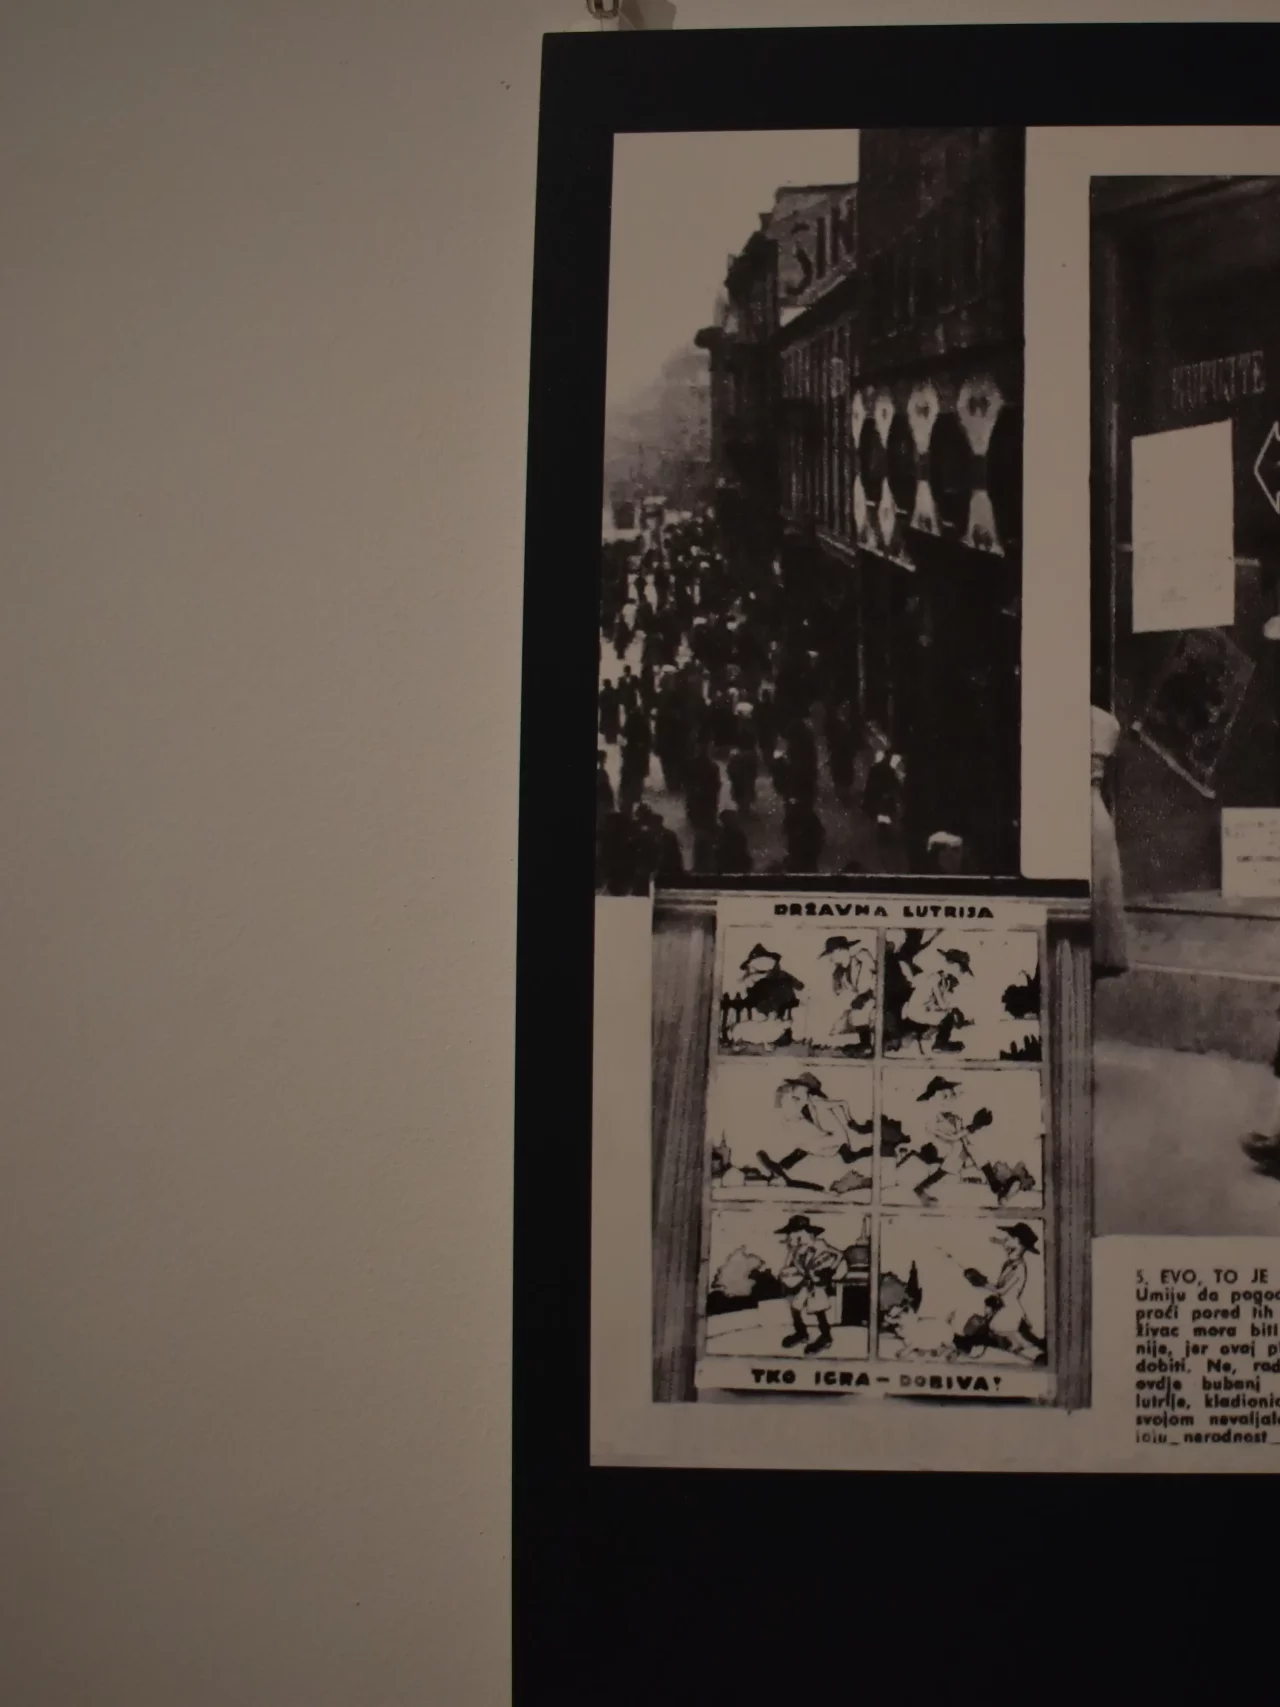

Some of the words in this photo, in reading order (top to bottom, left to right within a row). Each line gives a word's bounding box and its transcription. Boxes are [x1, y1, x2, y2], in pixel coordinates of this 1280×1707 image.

[773, 901, 889, 918] DRŽAVNA
[903, 905, 995, 919] LUTRIJA
[1160, 1268, 1201, 1286] EVO,
[1213, 1267, 1238, 1282] TO
[1251, 1267, 1268, 1282] JE
[1136, 1286, 1186, 1304] Umiju
[1197, 1285, 1219, 1300] da
[1136, 1304, 1178, 1322] proći
[1192, 1303, 1240, 1321] pored
[1252, 1303, 1273, 1318] tih
[1136, 1322, 1179, 1337] živac
[1193, 1325, 1237, 1336] mora
[1250, 1321, 1278, 1336] biti
[1136, 1340, 1172, 1358] nije,
[1185, 1339, 1208, 1357] jer
[1220, 1339, 1255, 1357] ovaj
[1207, 1356, 1236, 1374] Ne,
[751, 1368, 796, 1384] TKO
[1135, 1375, 1182, 1393] ovdje
